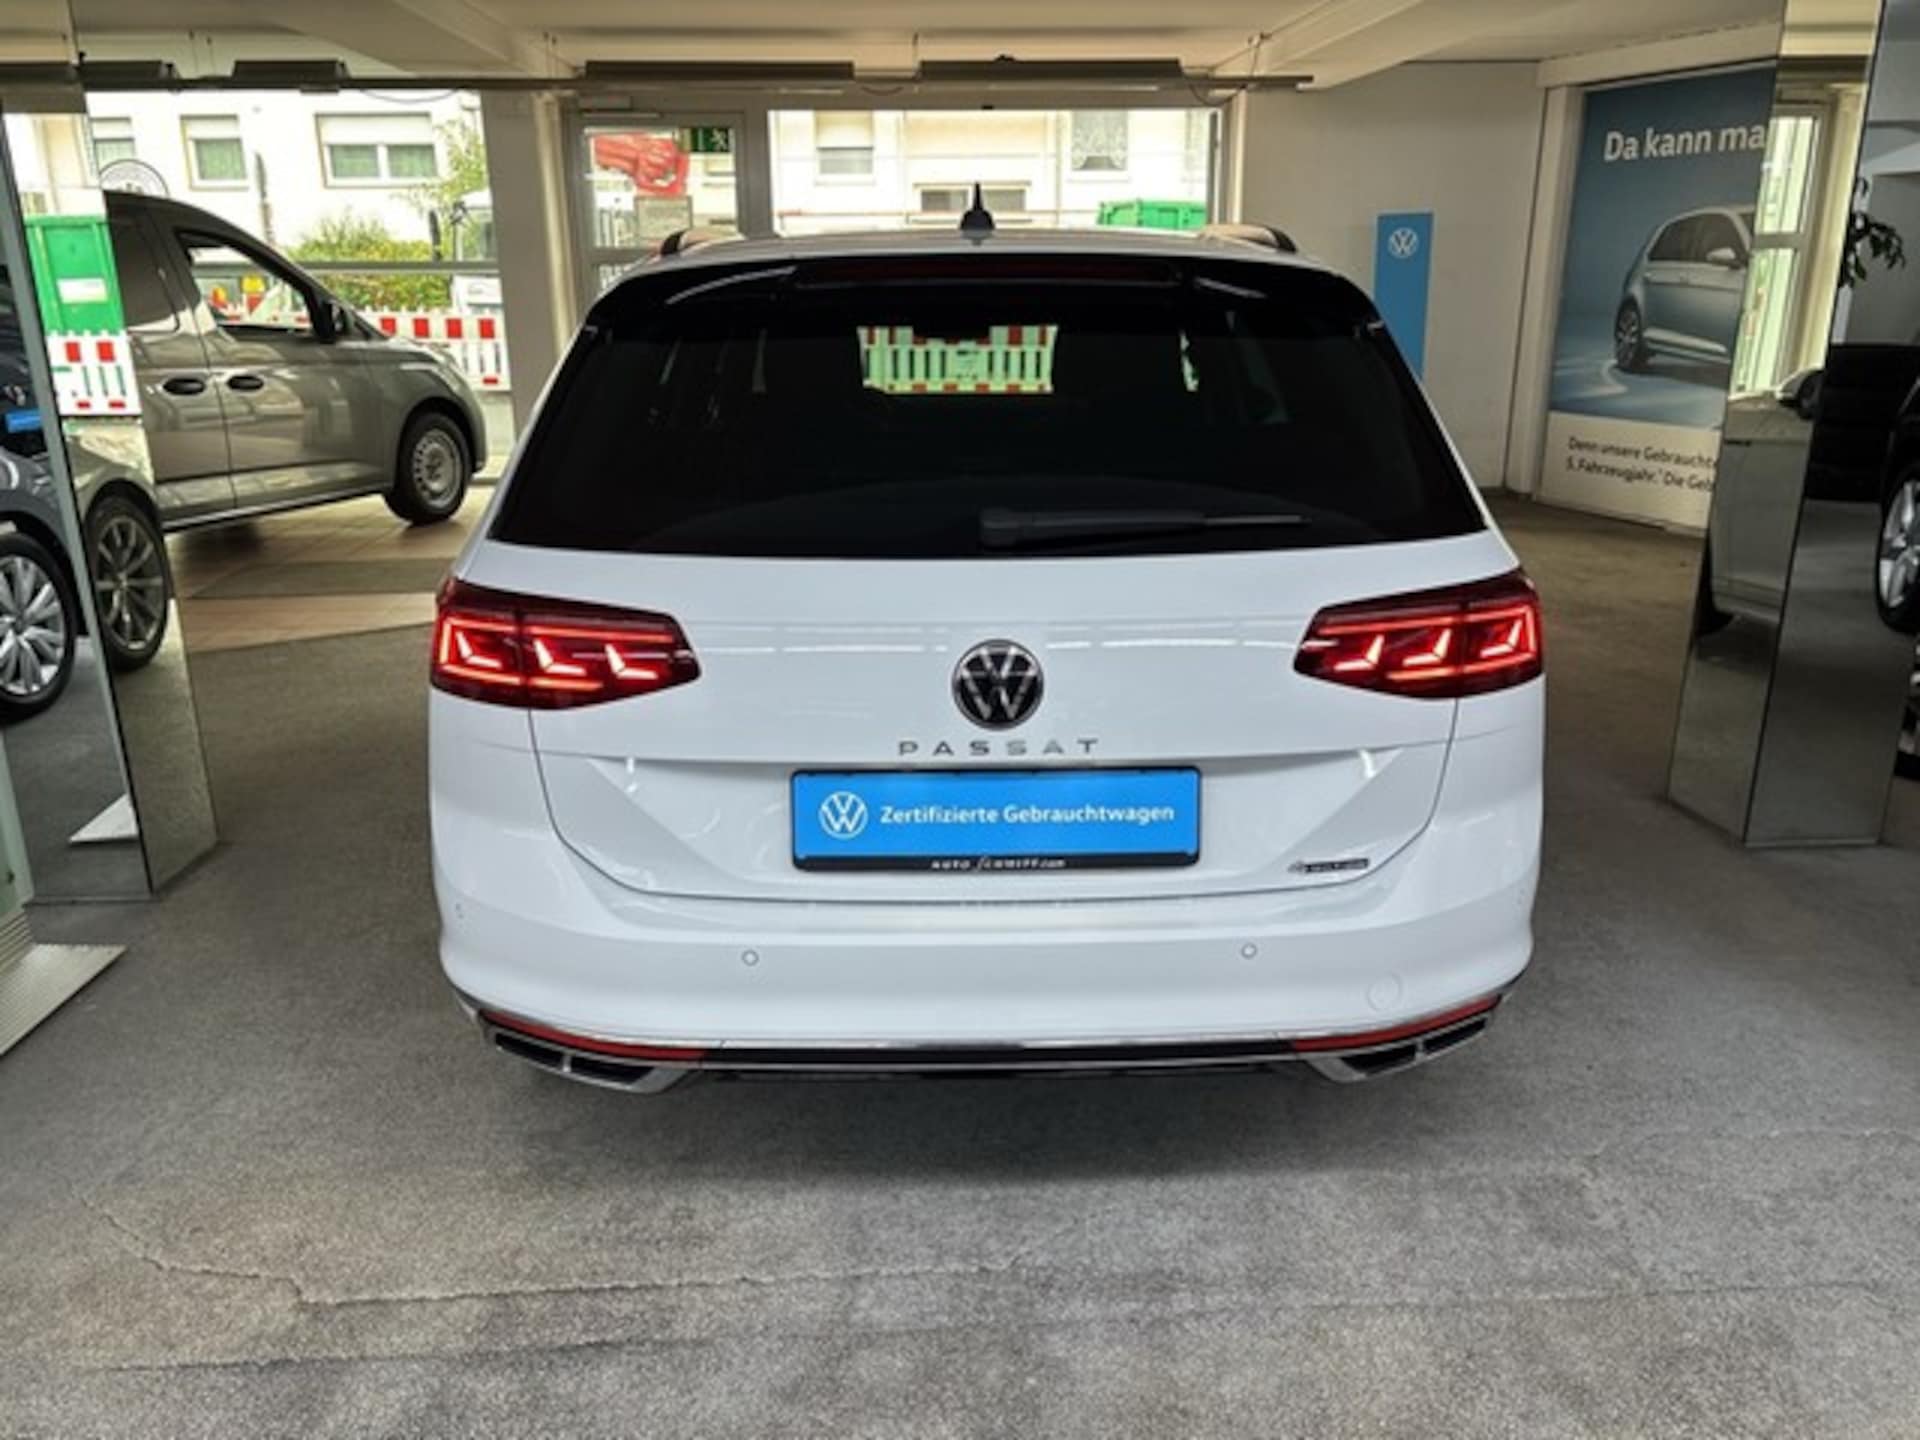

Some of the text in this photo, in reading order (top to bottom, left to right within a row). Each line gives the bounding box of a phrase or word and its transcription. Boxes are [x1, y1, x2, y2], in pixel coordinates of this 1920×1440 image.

[1603, 124, 1765, 162] Da kann ma
[1388, 227, 1419, 259] VW
[1568, 436, 1598, 451] Denn
[1601, 444, 1641, 460] unsere
[1663, 471, 1684, 486] Die
[952, 639, 1044, 731] VW
[898, 738, 1099, 757] PASSAT
[818, 791, 1175, 840] VW Zertifizierte Gebrauchtwagen
